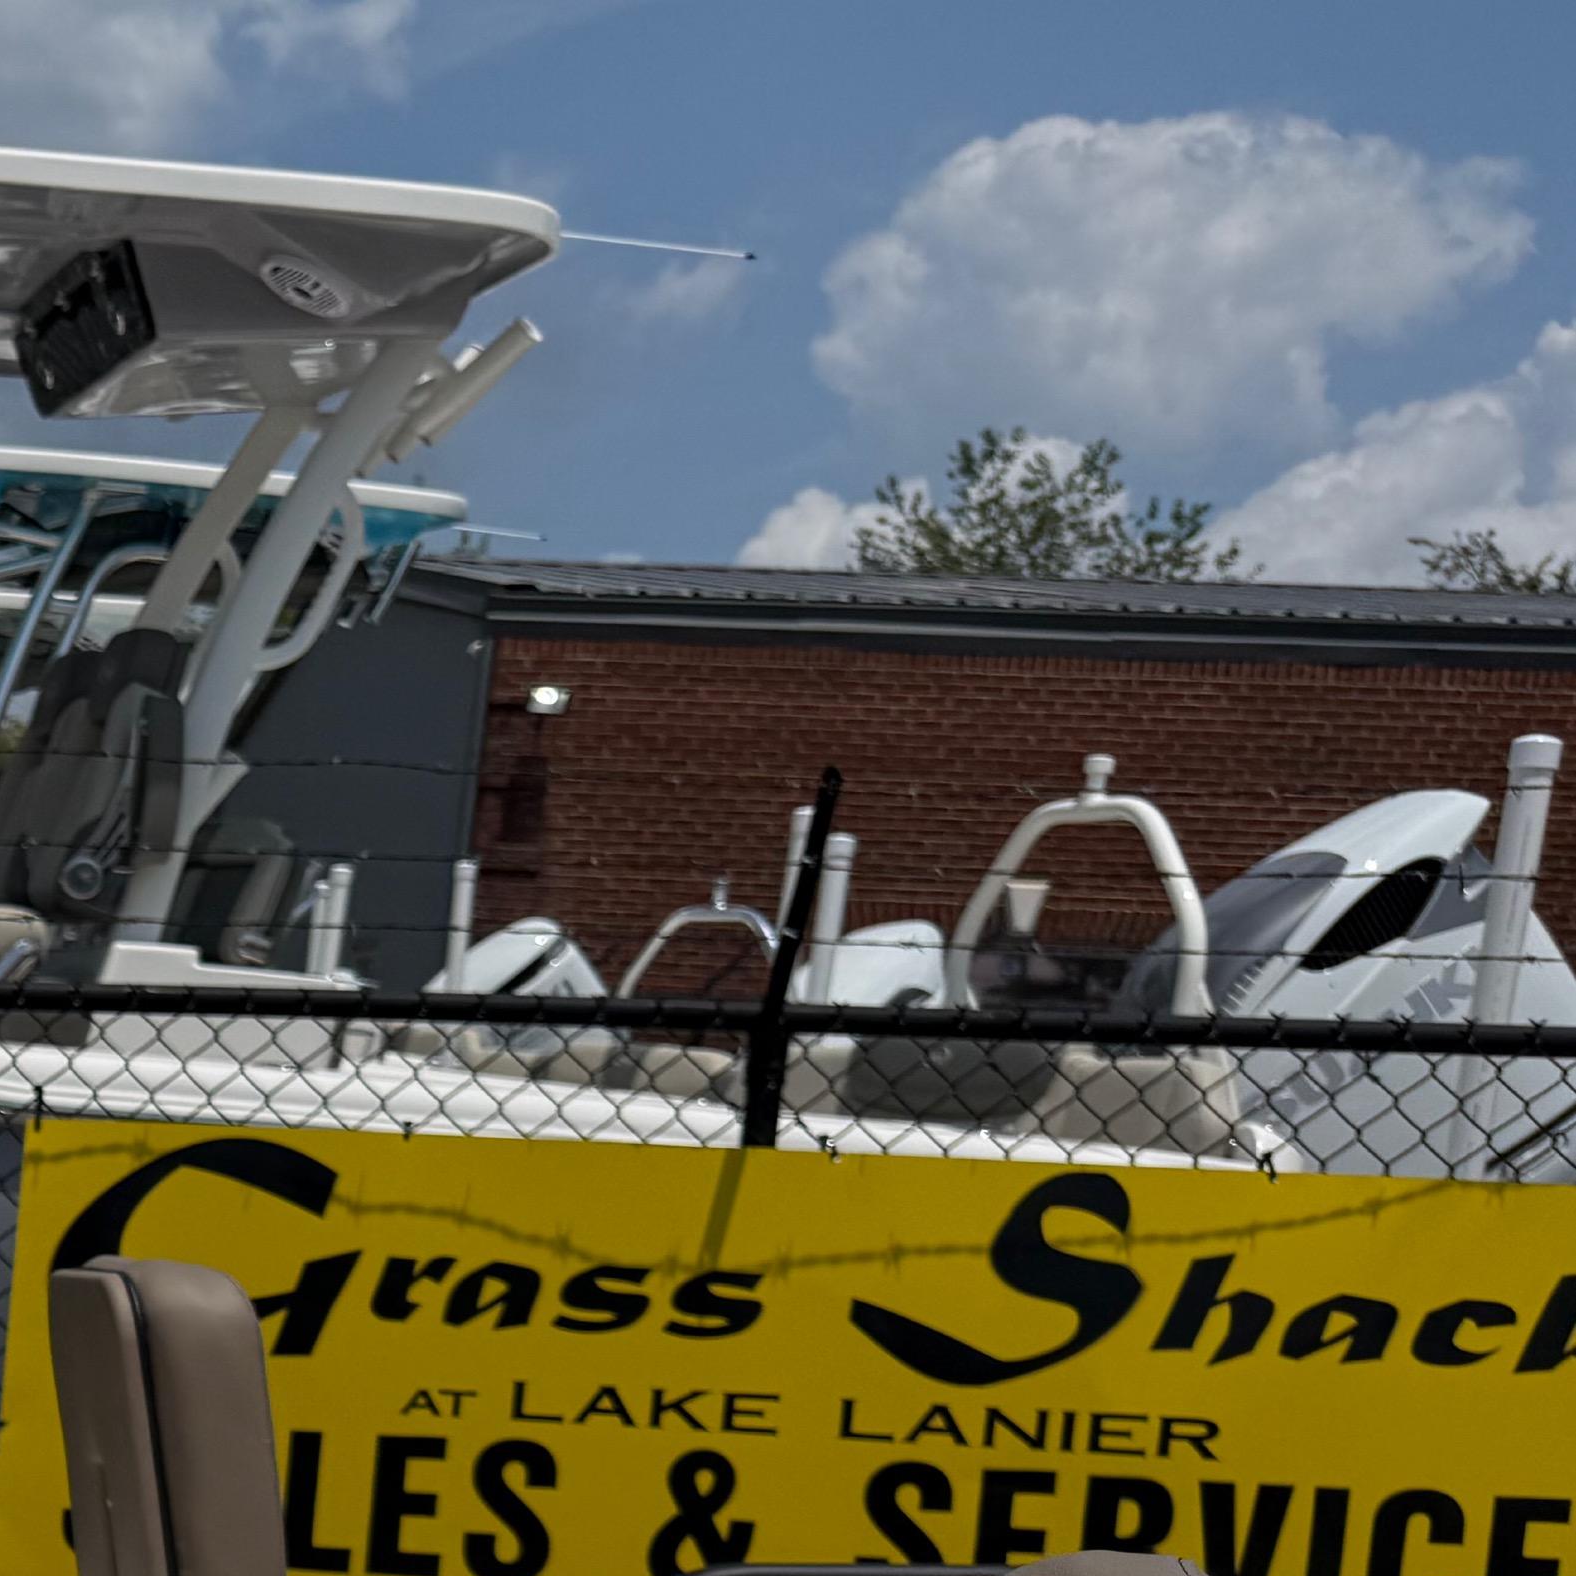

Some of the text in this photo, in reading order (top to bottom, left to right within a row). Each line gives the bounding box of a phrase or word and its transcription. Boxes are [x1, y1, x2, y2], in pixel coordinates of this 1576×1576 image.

[50, 1137, 767, 1357] Grass
[400, 1380, 1222, 1462] AT LAKE LANIER
